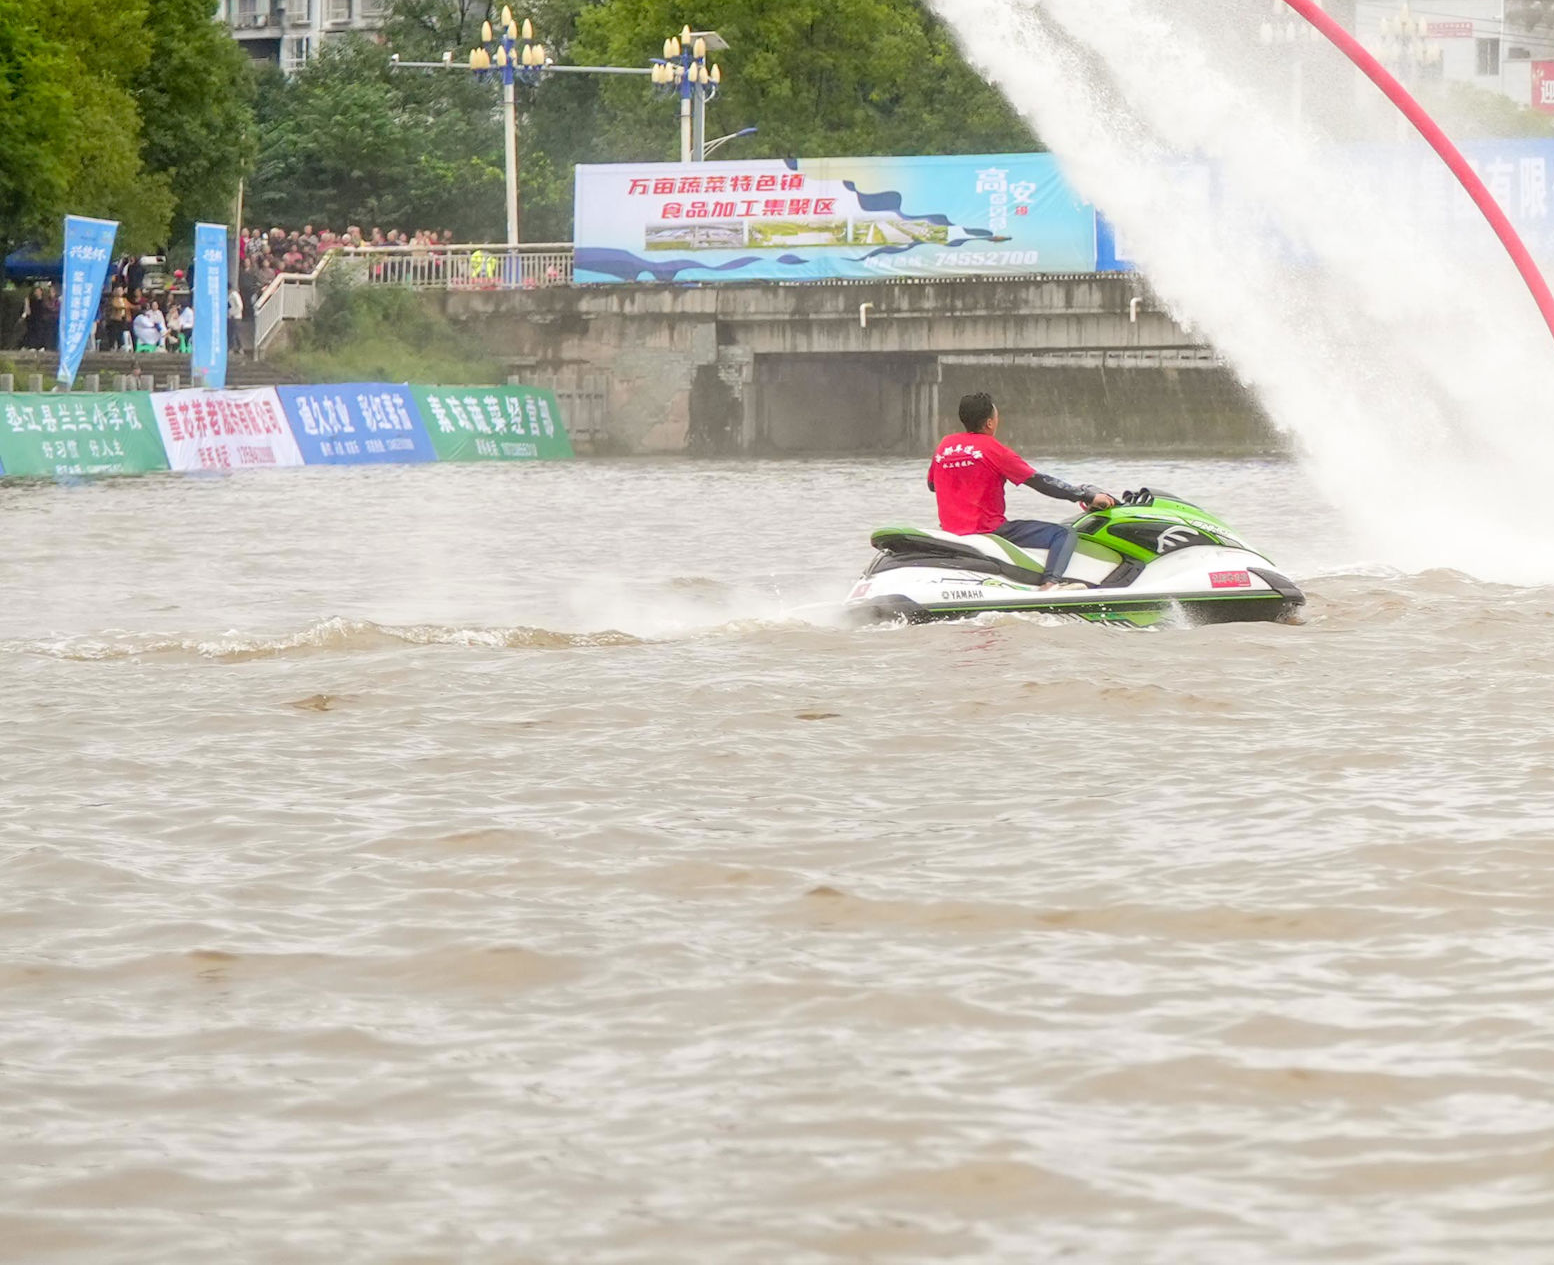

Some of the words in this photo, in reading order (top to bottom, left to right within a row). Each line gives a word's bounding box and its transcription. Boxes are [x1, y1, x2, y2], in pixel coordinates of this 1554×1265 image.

[628, 173, 805, 195] 万亩蔬菜特色镇
[975, 167, 1037, 203] 高安
[661, 198, 837, 219] 食品加工集聚区
[950, 589, 985, 601] YAMAHA
